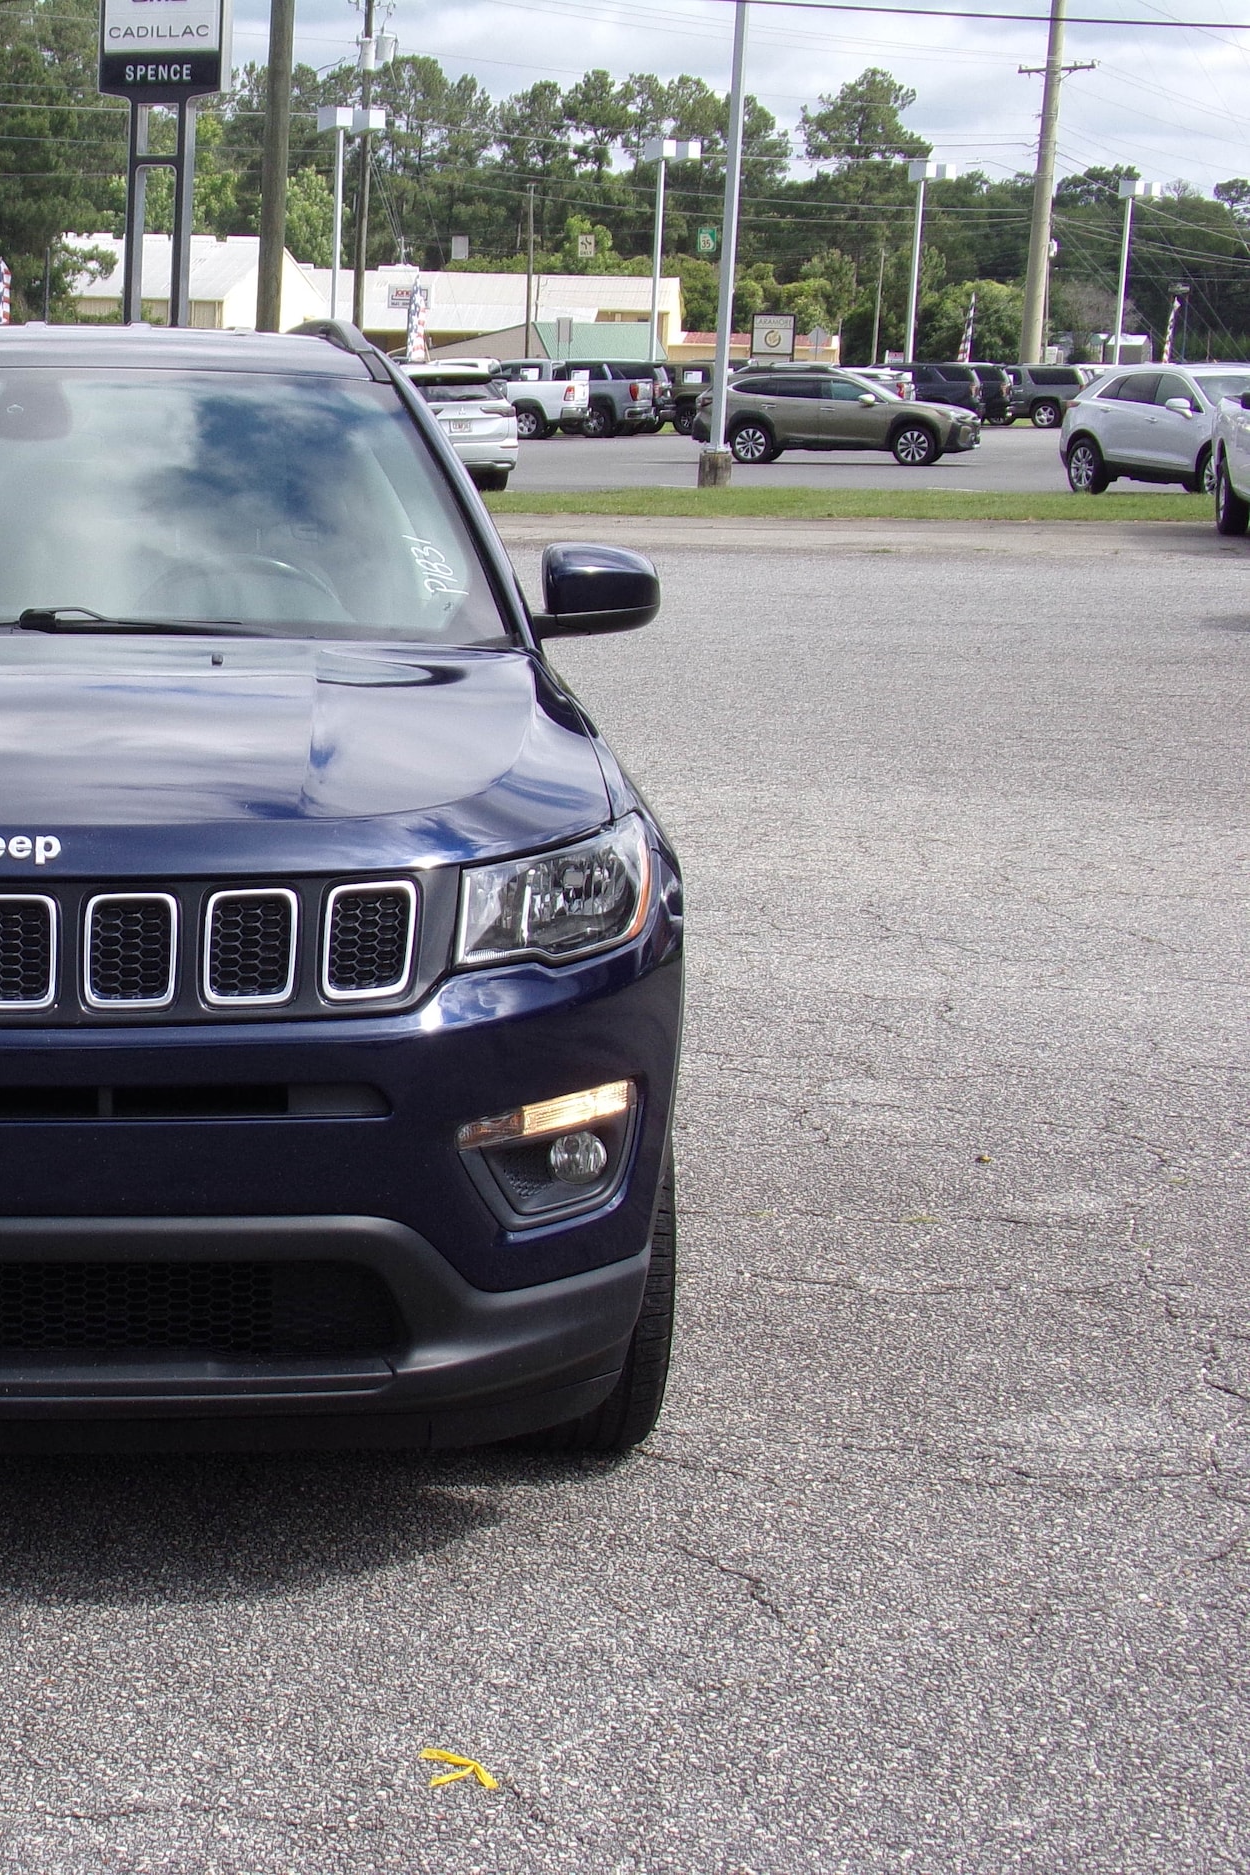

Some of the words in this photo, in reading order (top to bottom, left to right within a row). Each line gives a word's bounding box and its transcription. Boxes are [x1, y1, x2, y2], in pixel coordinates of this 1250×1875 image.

[109, 24, 210, 38] CADILLAC
[125, 64, 192, 81] SPENCE
[701, 239, 711, 249] 35
